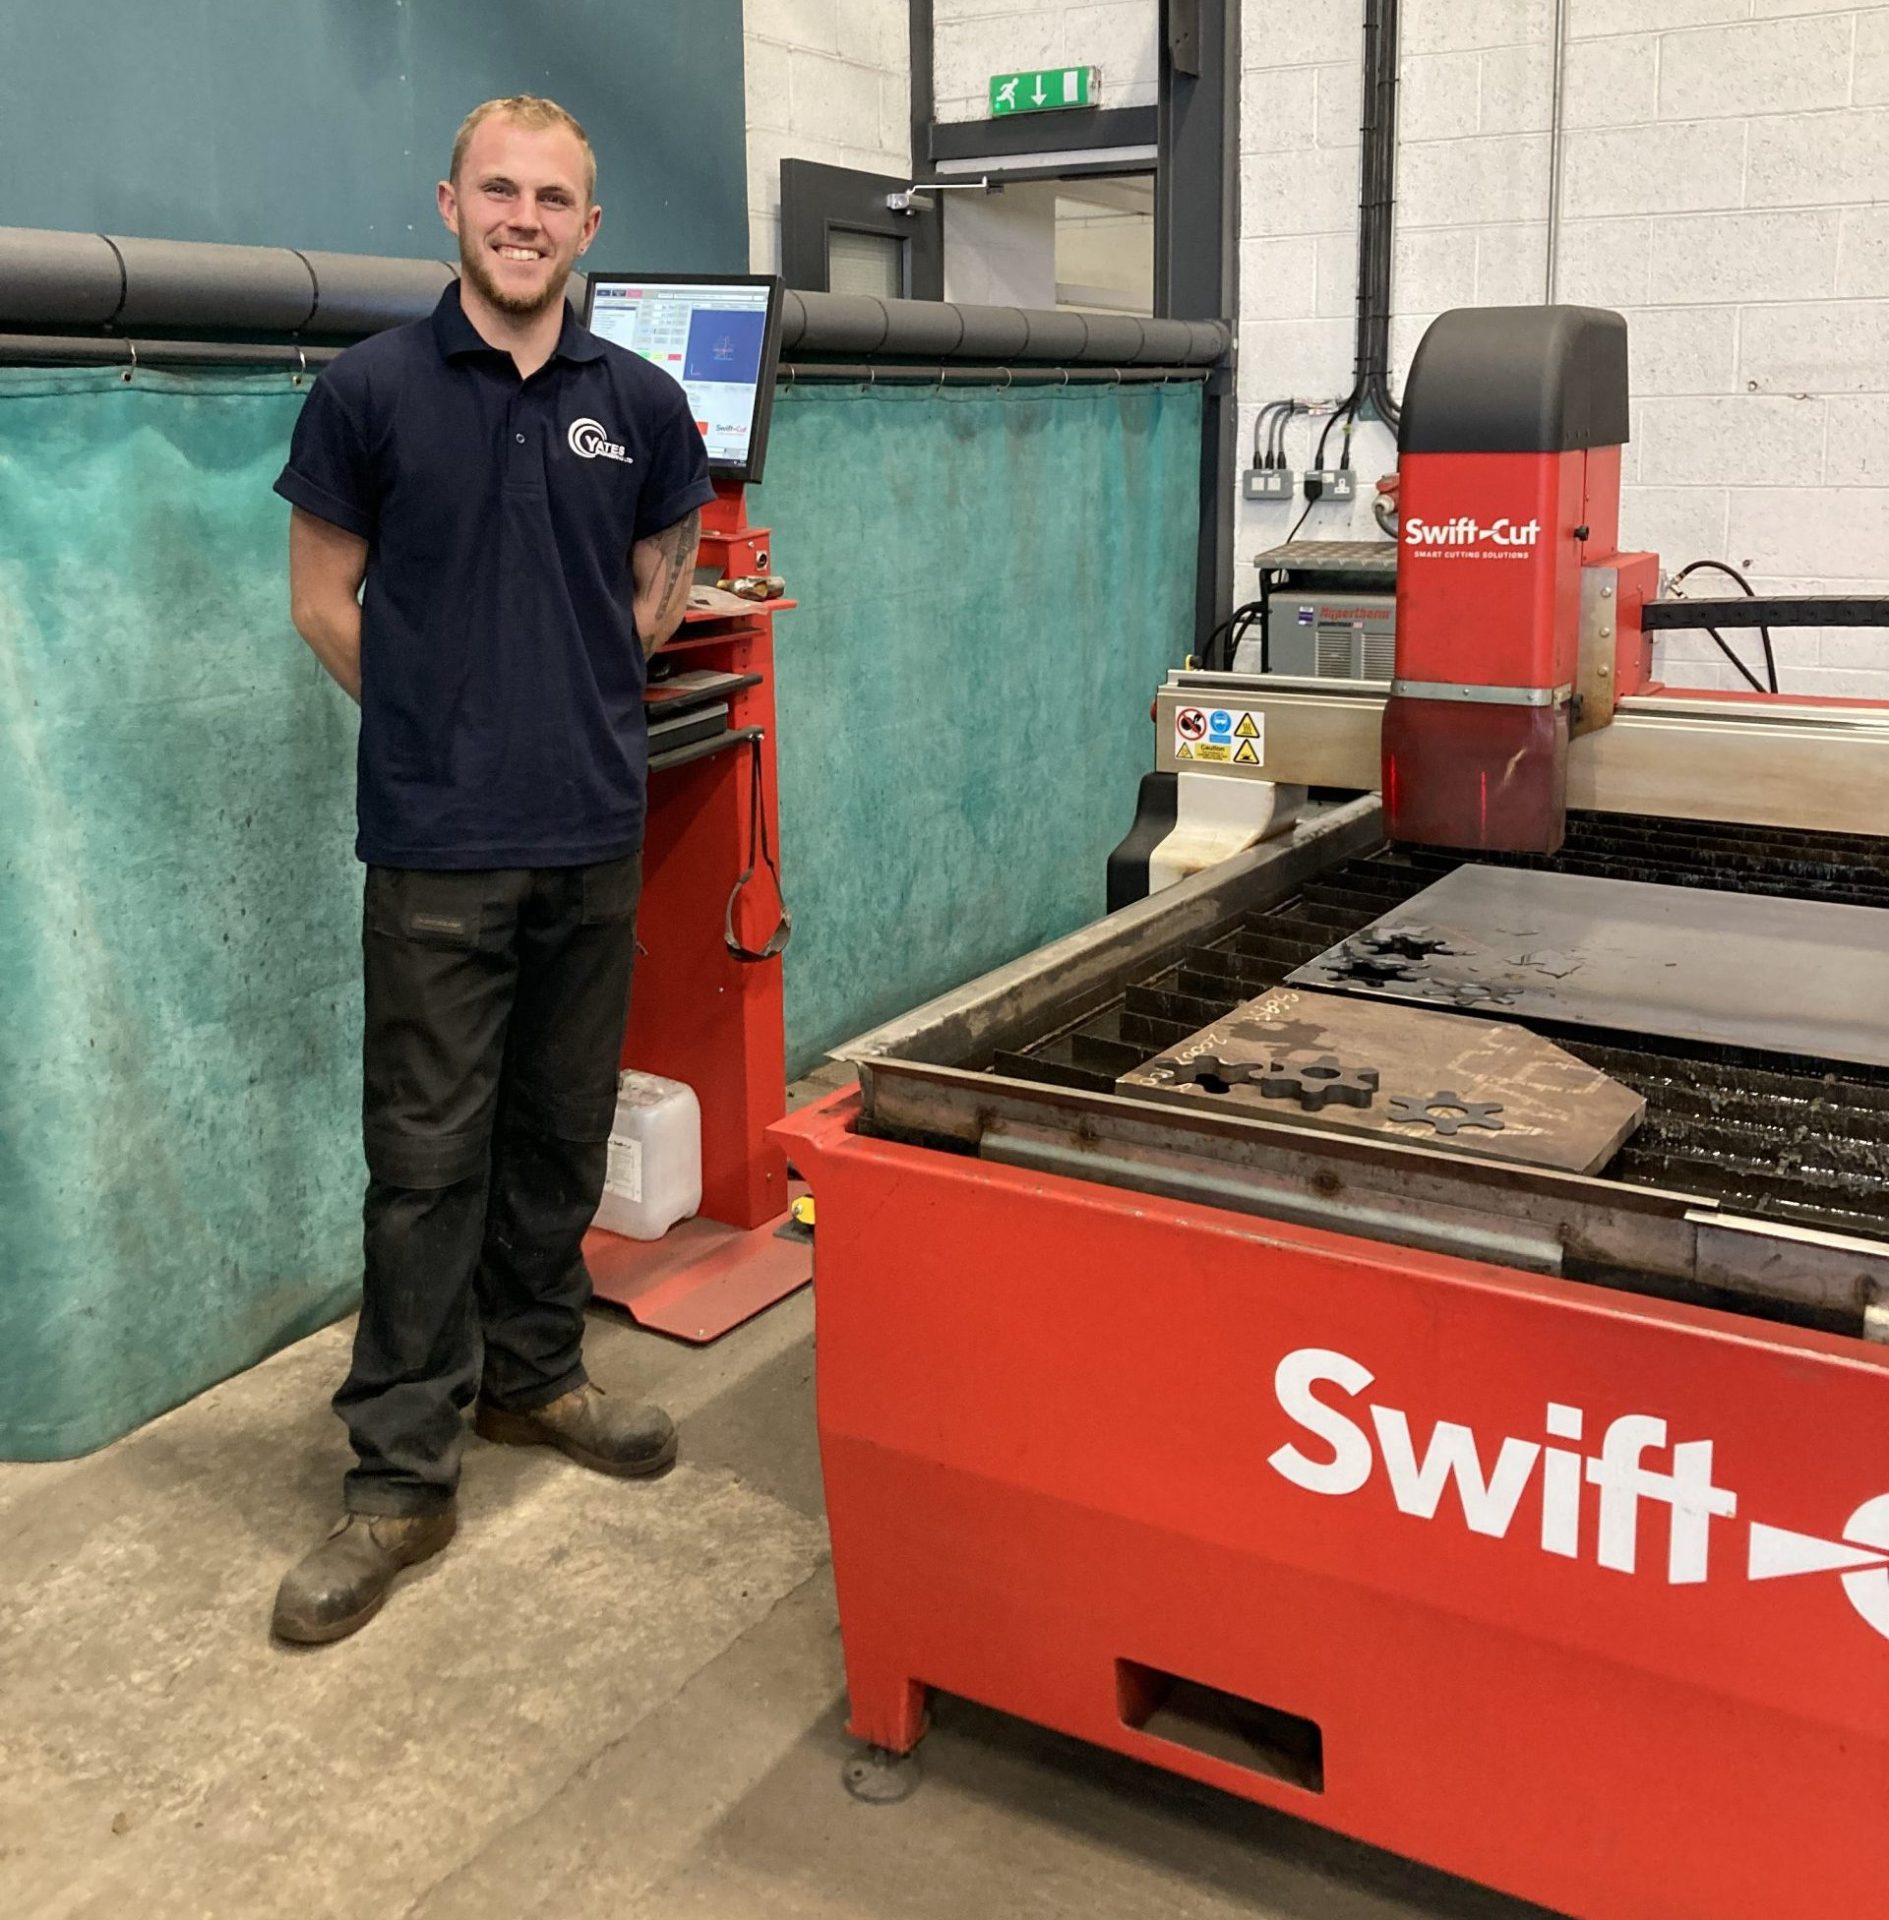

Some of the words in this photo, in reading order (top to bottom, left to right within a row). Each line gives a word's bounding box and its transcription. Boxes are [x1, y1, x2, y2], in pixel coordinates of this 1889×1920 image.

[585, 435, 625, 456] YATES
[1405, 517, 1541, 545] Swift-Cut
[1444, 551, 1480, 559] CUTTING
[1482, 551, 1529, 559] SOLUTIONS
